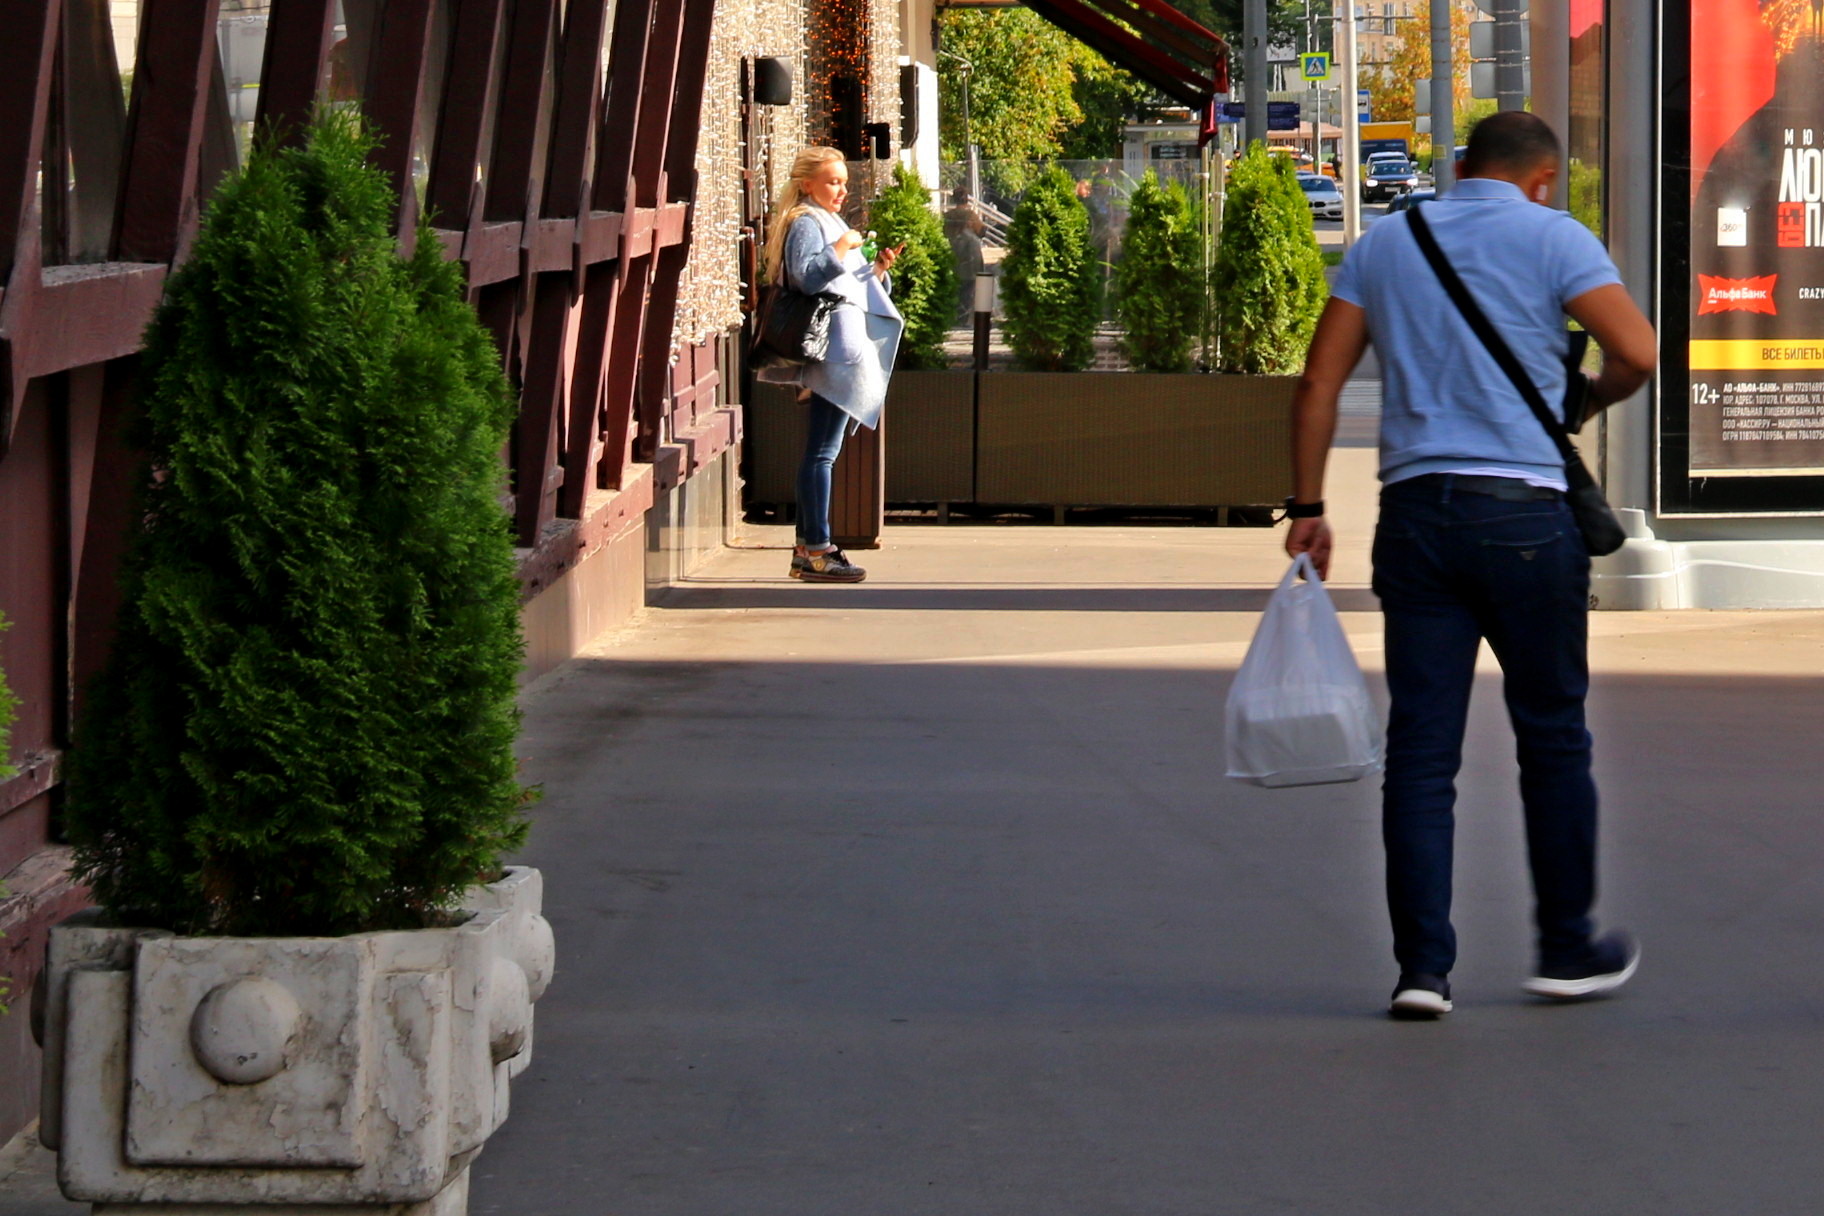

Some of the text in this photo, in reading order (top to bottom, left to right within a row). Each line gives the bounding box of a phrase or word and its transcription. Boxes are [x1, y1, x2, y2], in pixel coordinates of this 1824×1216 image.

[1778, 202, 1804, 247] БЕЗ
[1762, 347, 1824, 360] ВСЕ БИЛЕТЫ
[1723, 382, 1733, 392] АО
[1692, 383, 1720, 404] 12+
[1723, 406, 1763, 416] ГЕНЕРАЛЬНАЯ
[1795, 406, 1815, 416] БАНКА
[1723, 419, 1736, 429] ООО
[1723, 431, 1739, 441] ОГРН
